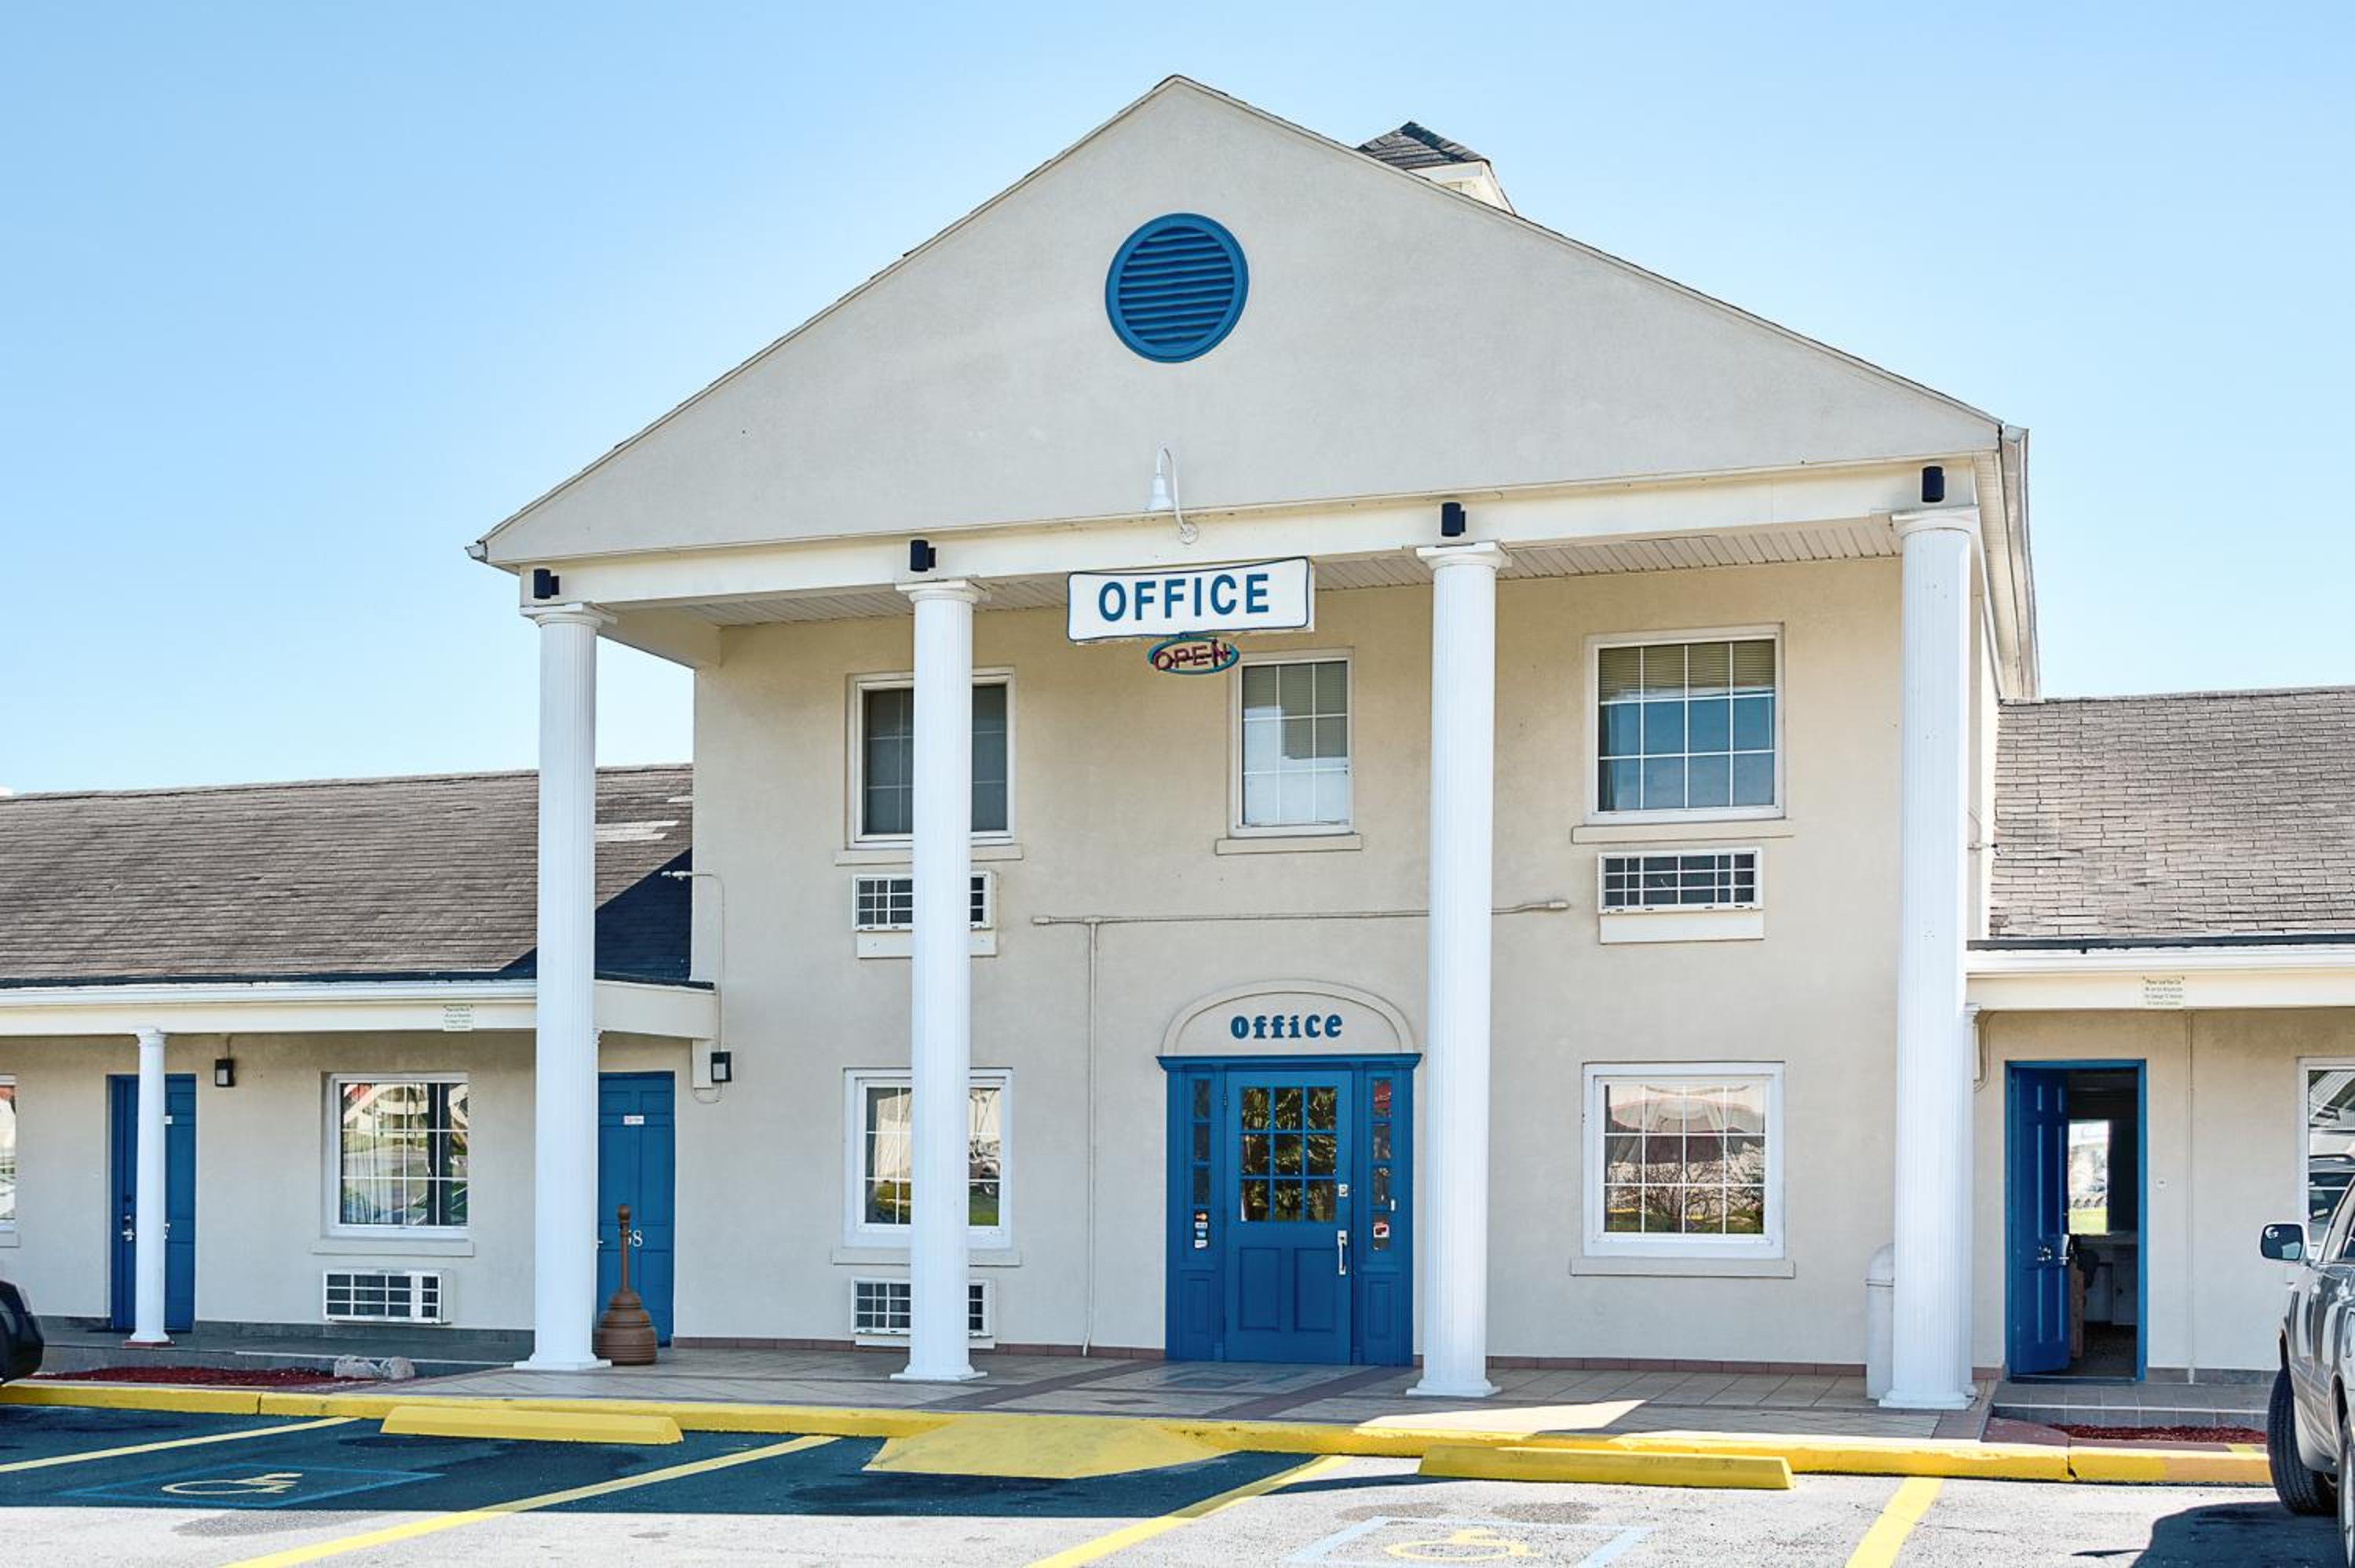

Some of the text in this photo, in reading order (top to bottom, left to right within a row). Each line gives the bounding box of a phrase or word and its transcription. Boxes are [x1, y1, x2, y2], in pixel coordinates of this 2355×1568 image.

[1099, 574, 1269, 622] OFFICE
[1153, 639, 1229, 670] OPEN
[1231, 1014, 1342, 1039] office
